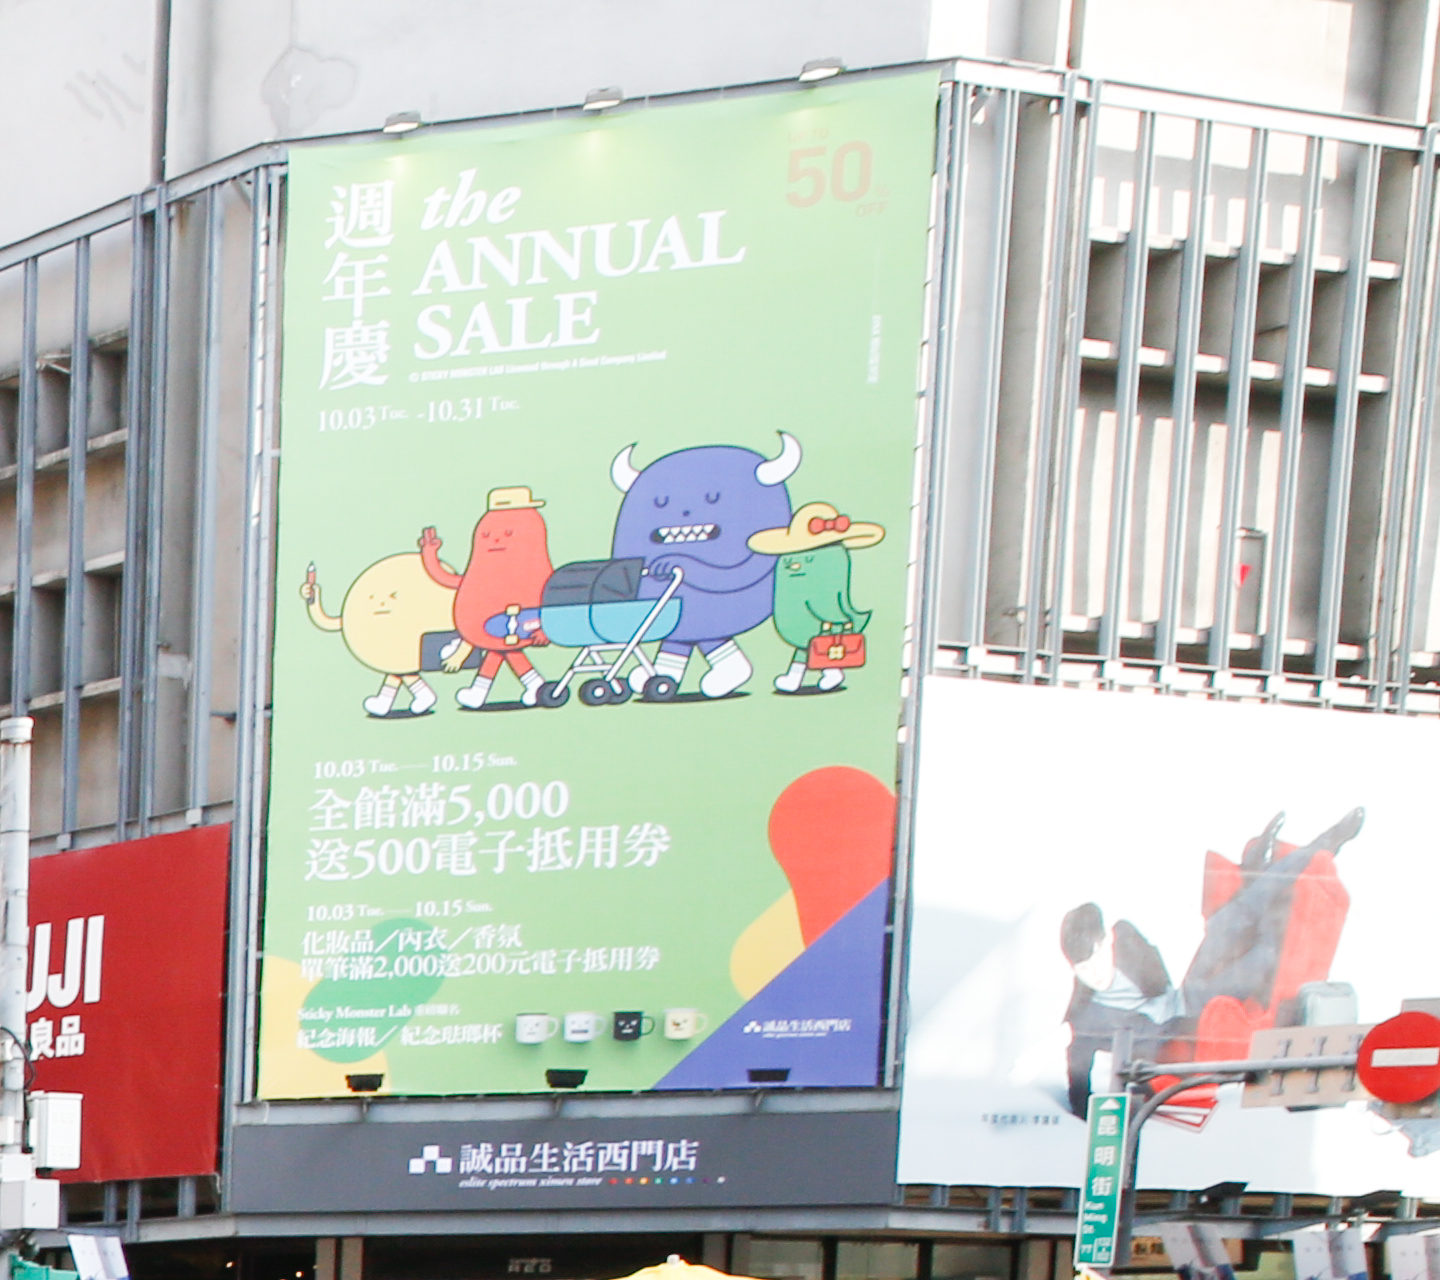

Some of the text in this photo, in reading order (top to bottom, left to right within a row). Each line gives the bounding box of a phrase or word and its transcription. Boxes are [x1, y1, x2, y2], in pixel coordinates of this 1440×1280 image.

[420, 168, 521, 231] the
[786, 139, 873, 208] 50
[411, 210, 746, 296] ANNUAL
[319, 179, 395, 390] 週年慶
[414, 291, 601, 361] SALE
[319, 408, 377, 432] 10.03
[313, 759, 365, 779] 10.03
[431, 752, 484, 773] 10.15
[308, 780, 570, 833] 全館滿5,000
[303, 822, 672, 881] 送500電子抵用券
[306, 903, 354, 922] 10.03
[414, 899, 463, 919] 10.15
[336, 1006, 387, 1019] Monster
[388, 1005, 411, 1017] Lab
[459, 1139, 700, 1174] 誠品生活西門店
[488, 1177, 537, 1190] spectrum
[539, 1175, 574, 1188] ximen
[576, 1177, 603, 1188] store
[1092, 1115, 1119, 1197] 昆明街
